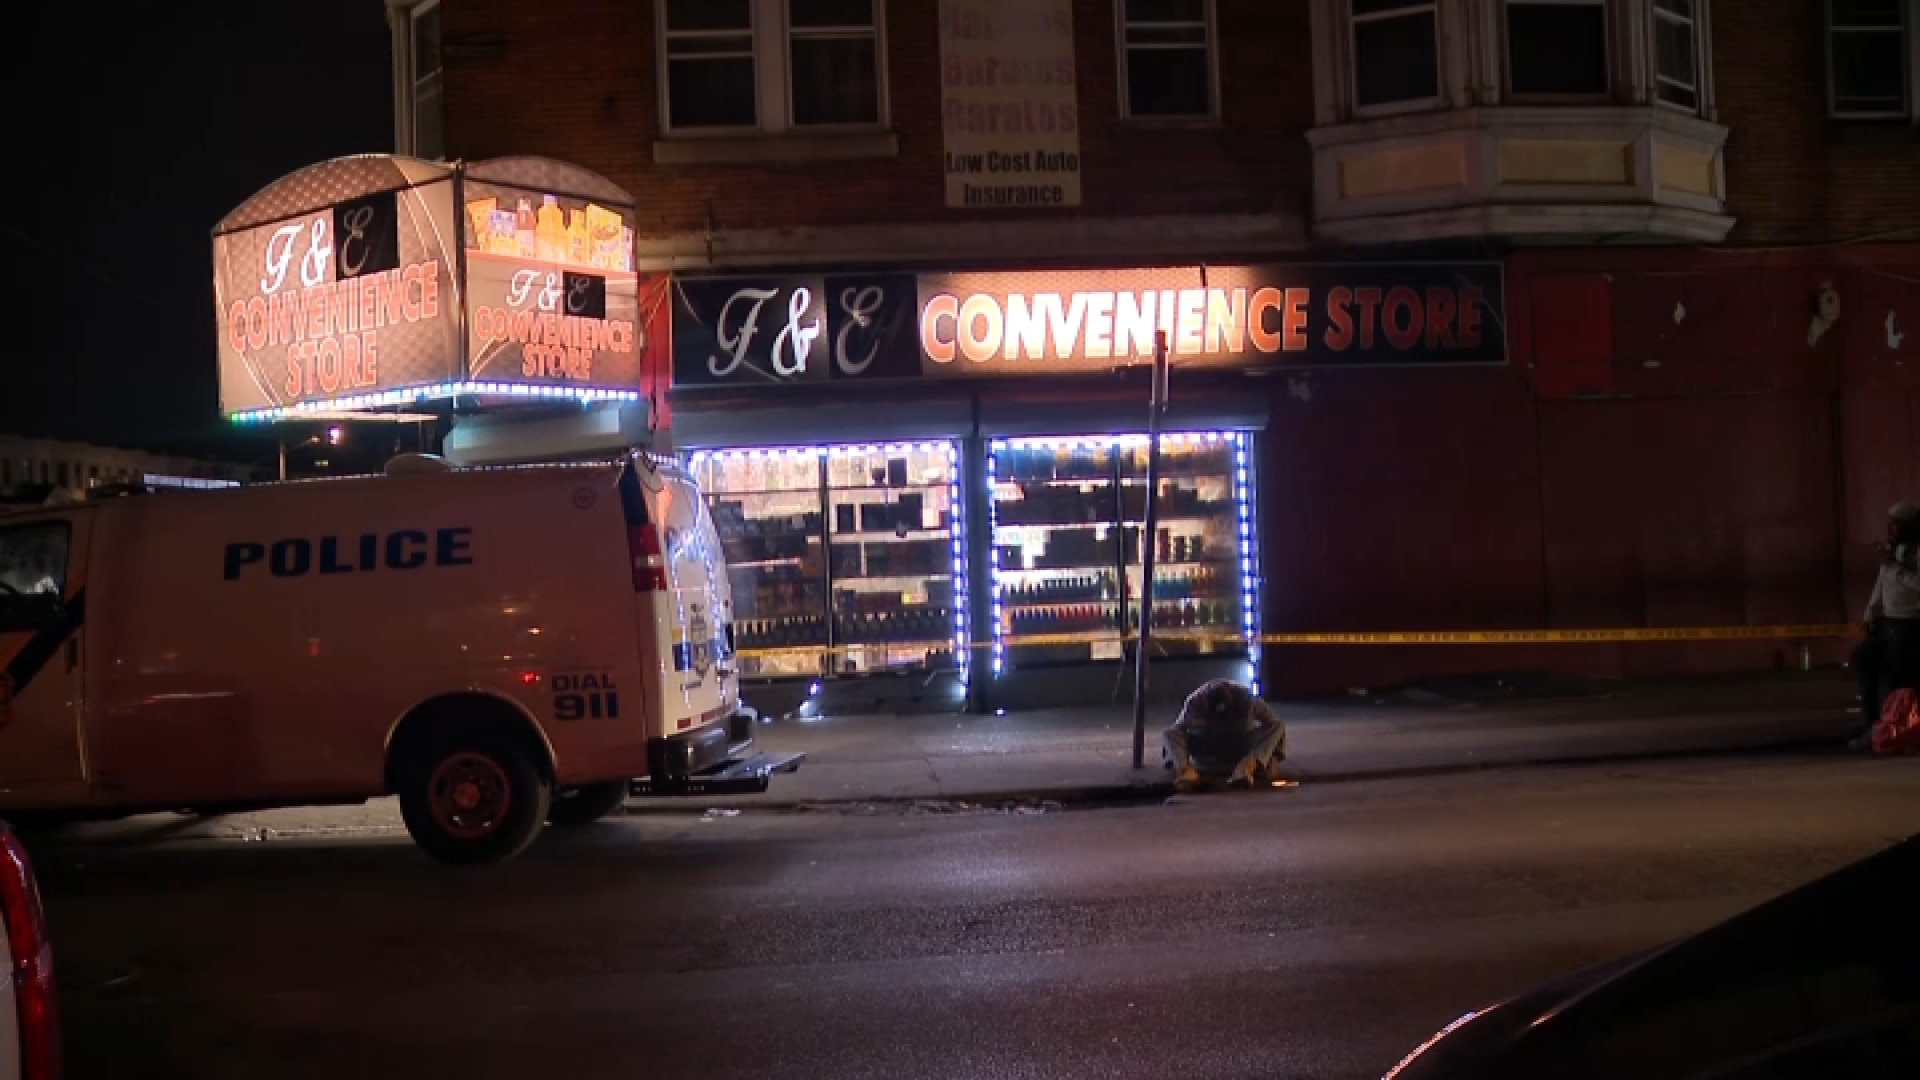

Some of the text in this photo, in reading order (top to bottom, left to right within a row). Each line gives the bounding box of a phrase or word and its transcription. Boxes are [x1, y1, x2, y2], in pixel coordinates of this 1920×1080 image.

[946, 150, 1079, 173] Low Cost Auto
[964, 183, 1065, 205] Insurance
[300, 217, 332, 288] &
[228, 260, 439, 354] CONVENIENCE
[538, 273, 561, 311] &
[474, 305, 633, 353] CONVENIENCE
[770, 286, 821, 377] &
[835, 285, 884, 375] E
[920, 286, 1311, 363] CONVENIENCE
[1323, 285, 1486, 352] STORE
[285, 330, 379, 397] STORE
[521, 342, 593, 381] STORE
[223, 525, 473, 581] POLICE
[552, 673, 616, 691] DIAL
[554, 691, 619, 720] 911
